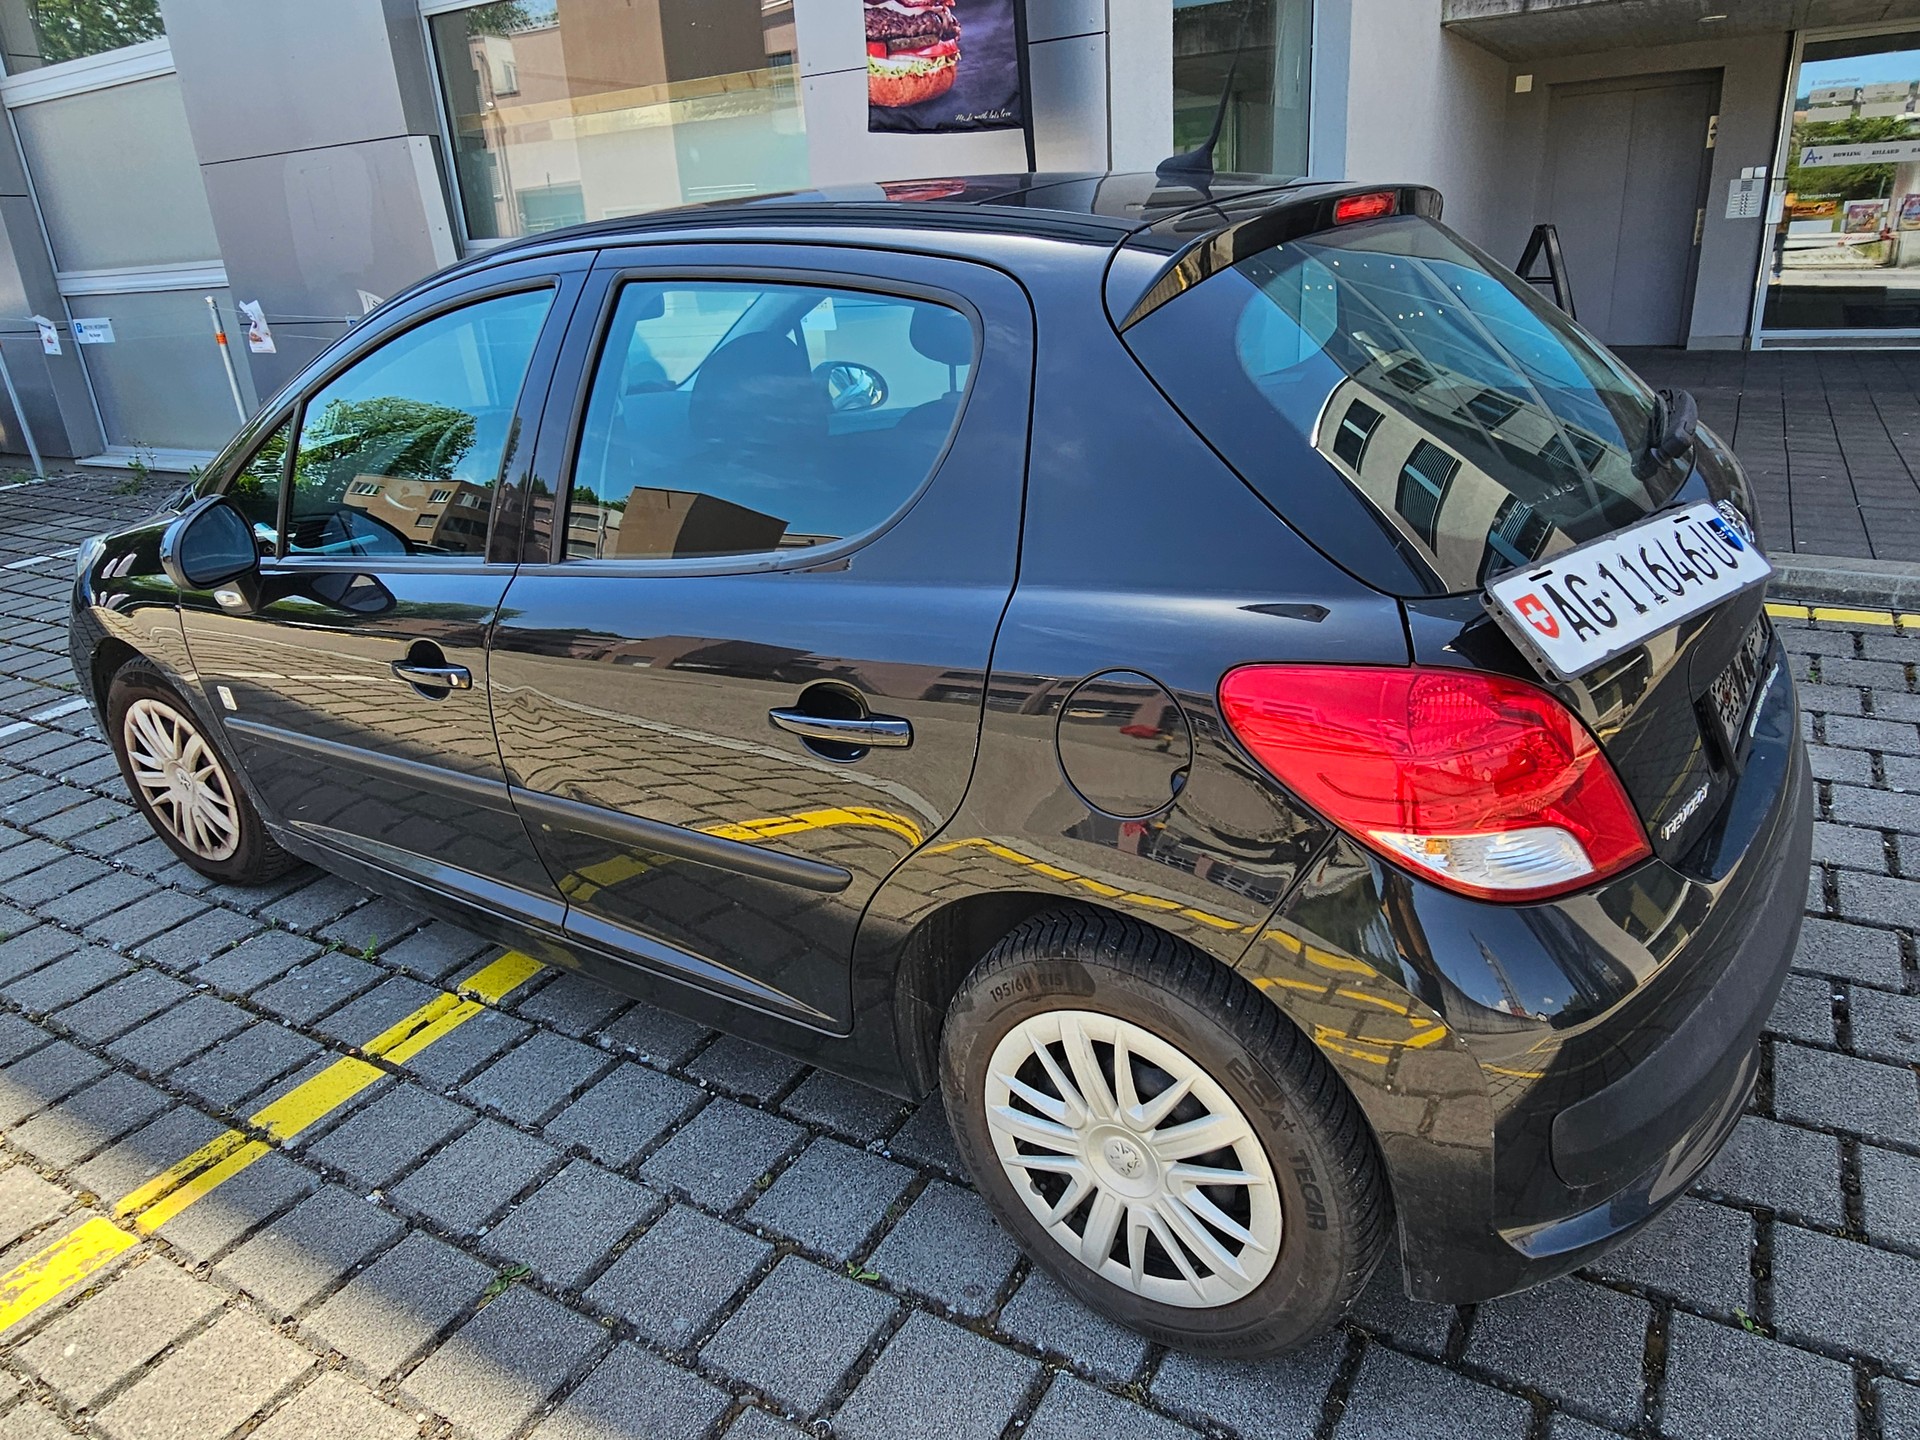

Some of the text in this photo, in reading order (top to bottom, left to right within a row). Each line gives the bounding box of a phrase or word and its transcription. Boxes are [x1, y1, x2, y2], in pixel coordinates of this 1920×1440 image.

[1833, 150, 1862, 158] BOWLING
[1871, 148, 1900, 156] BILLARD
[989, 972, 1032, 1003] 195/60
[1288, 1149, 1329, 1232] TECAR
